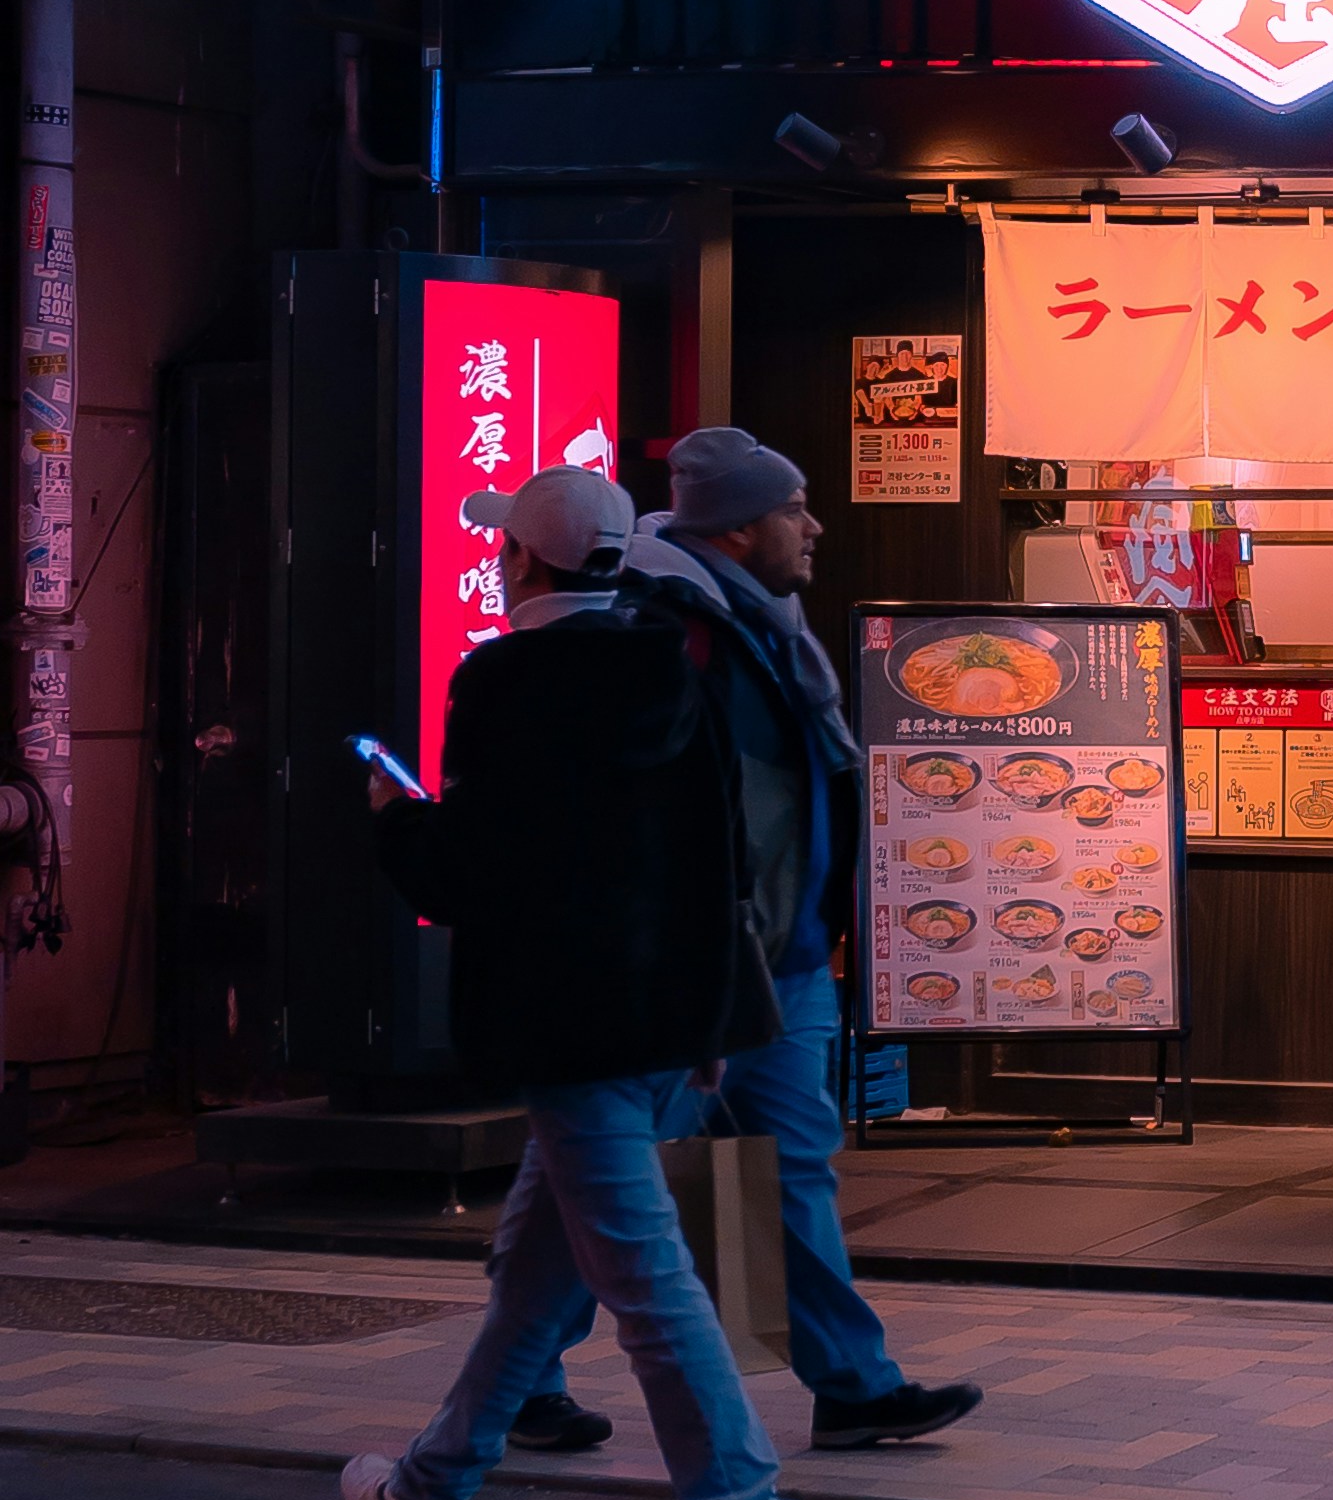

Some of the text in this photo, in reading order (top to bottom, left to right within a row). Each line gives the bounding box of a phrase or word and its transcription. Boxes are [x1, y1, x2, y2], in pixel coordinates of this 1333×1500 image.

[1203, 687, 1299, 706] ご注文方法
[1208, 706, 1293, 716] HOW TO ORDER
[895, 717, 1004, 735] 濃厚味噌らーめん
